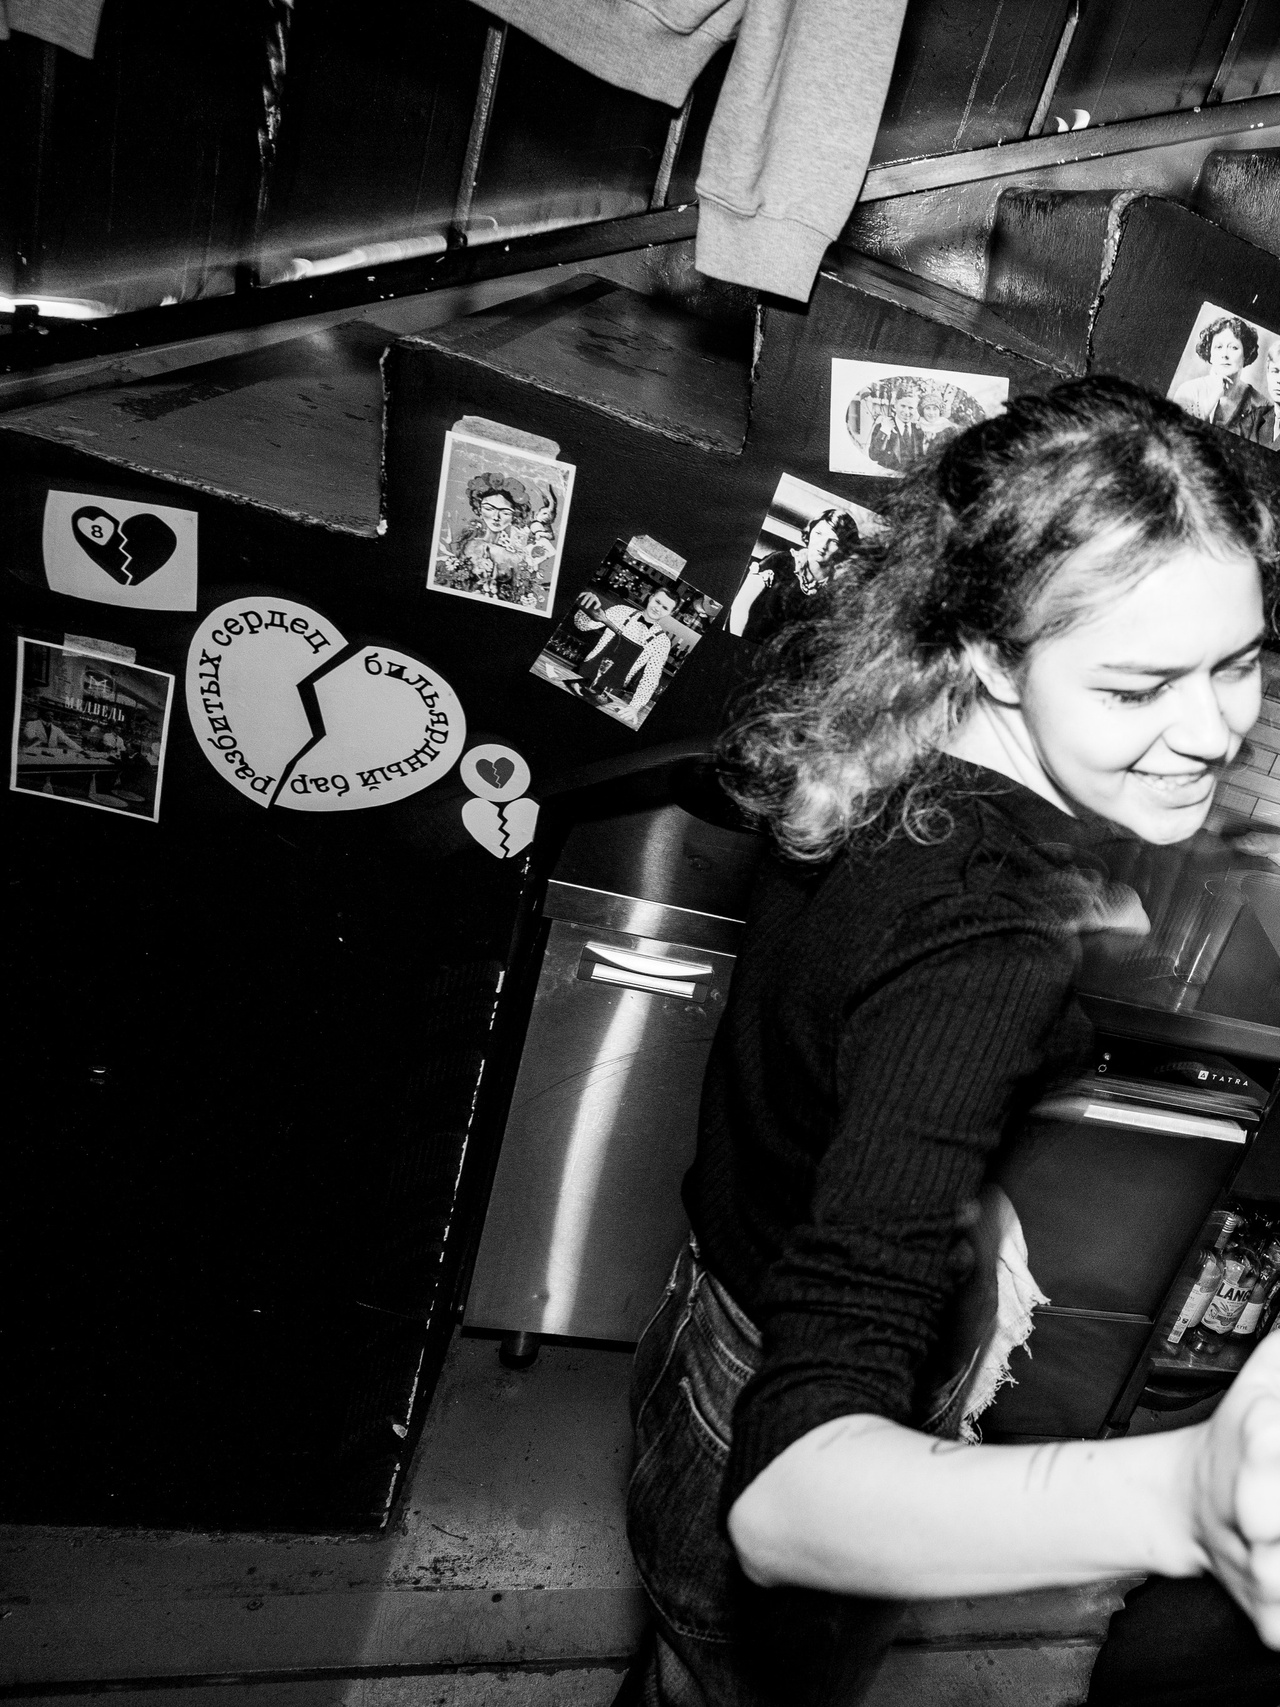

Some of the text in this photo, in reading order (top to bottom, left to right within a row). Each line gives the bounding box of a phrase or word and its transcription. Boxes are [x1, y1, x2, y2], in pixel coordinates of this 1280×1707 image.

[90, 524, 104, 539] 8
[64, 696, 125, 722] МЕДВЕДЬ
[198, 609, 332, 795] разбитых сердец
[290, 652, 450, 797] бильярдный бар
[1212, 1073, 1249, 1087] TATRA
